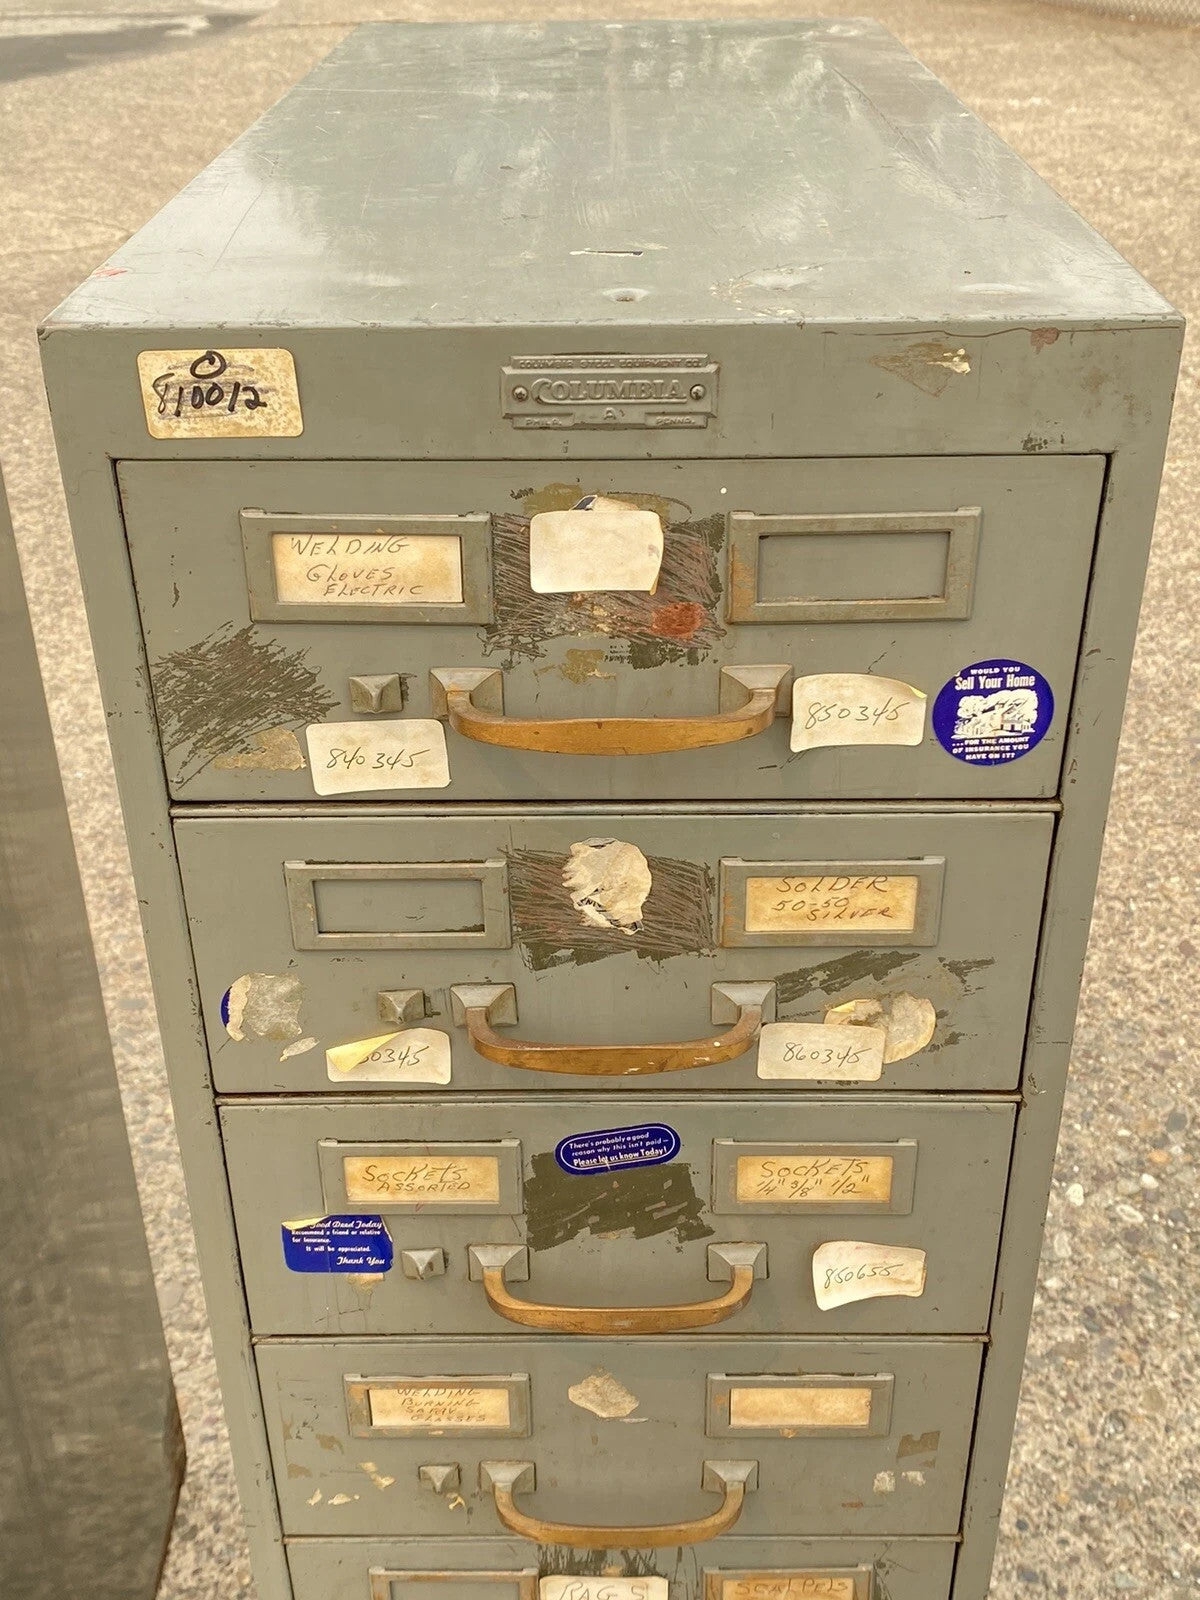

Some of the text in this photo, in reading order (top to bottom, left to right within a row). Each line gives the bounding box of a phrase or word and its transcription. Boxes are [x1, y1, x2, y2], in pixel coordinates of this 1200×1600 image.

[531, 378, 687, 404] COLUMBIA
[291, 534, 409, 556] WELDING
[306, 564, 395, 582] GLOVES
[324, 583, 424, 597] ELECTRIC
[970, 667, 1000, 675] WOULD
[955, 674, 1036, 691] Sell Your Home
[998, 736, 1030, 744] AMOUNT
[965, 745, 1011, 753] INSURANCE
[776, 875, 889, 893] SOLDER
[806, 906, 894, 922] SILVER
[595, 1136, 626, 1148] probably
[632, 1132, 650, 1141] good
[572, 1148, 596, 1157] reason
[596, 1146, 611, 1154] why
[613, 1142, 627, 1150] this
[573, 1158, 598, 1166] Please
[619, 1151, 640, 1160] know
[640, 1146, 668, 1157] Today!
[362, 1163, 467, 1182] SOCKETS
[761, 1158, 869, 1178] SOCKETS
[332, 1220, 355, 1228] Deed
[355, 1220, 382, 1229] Today
[336, 1256, 386, 1266] Thank You
[559, 1580, 645, 1600] RAGS
